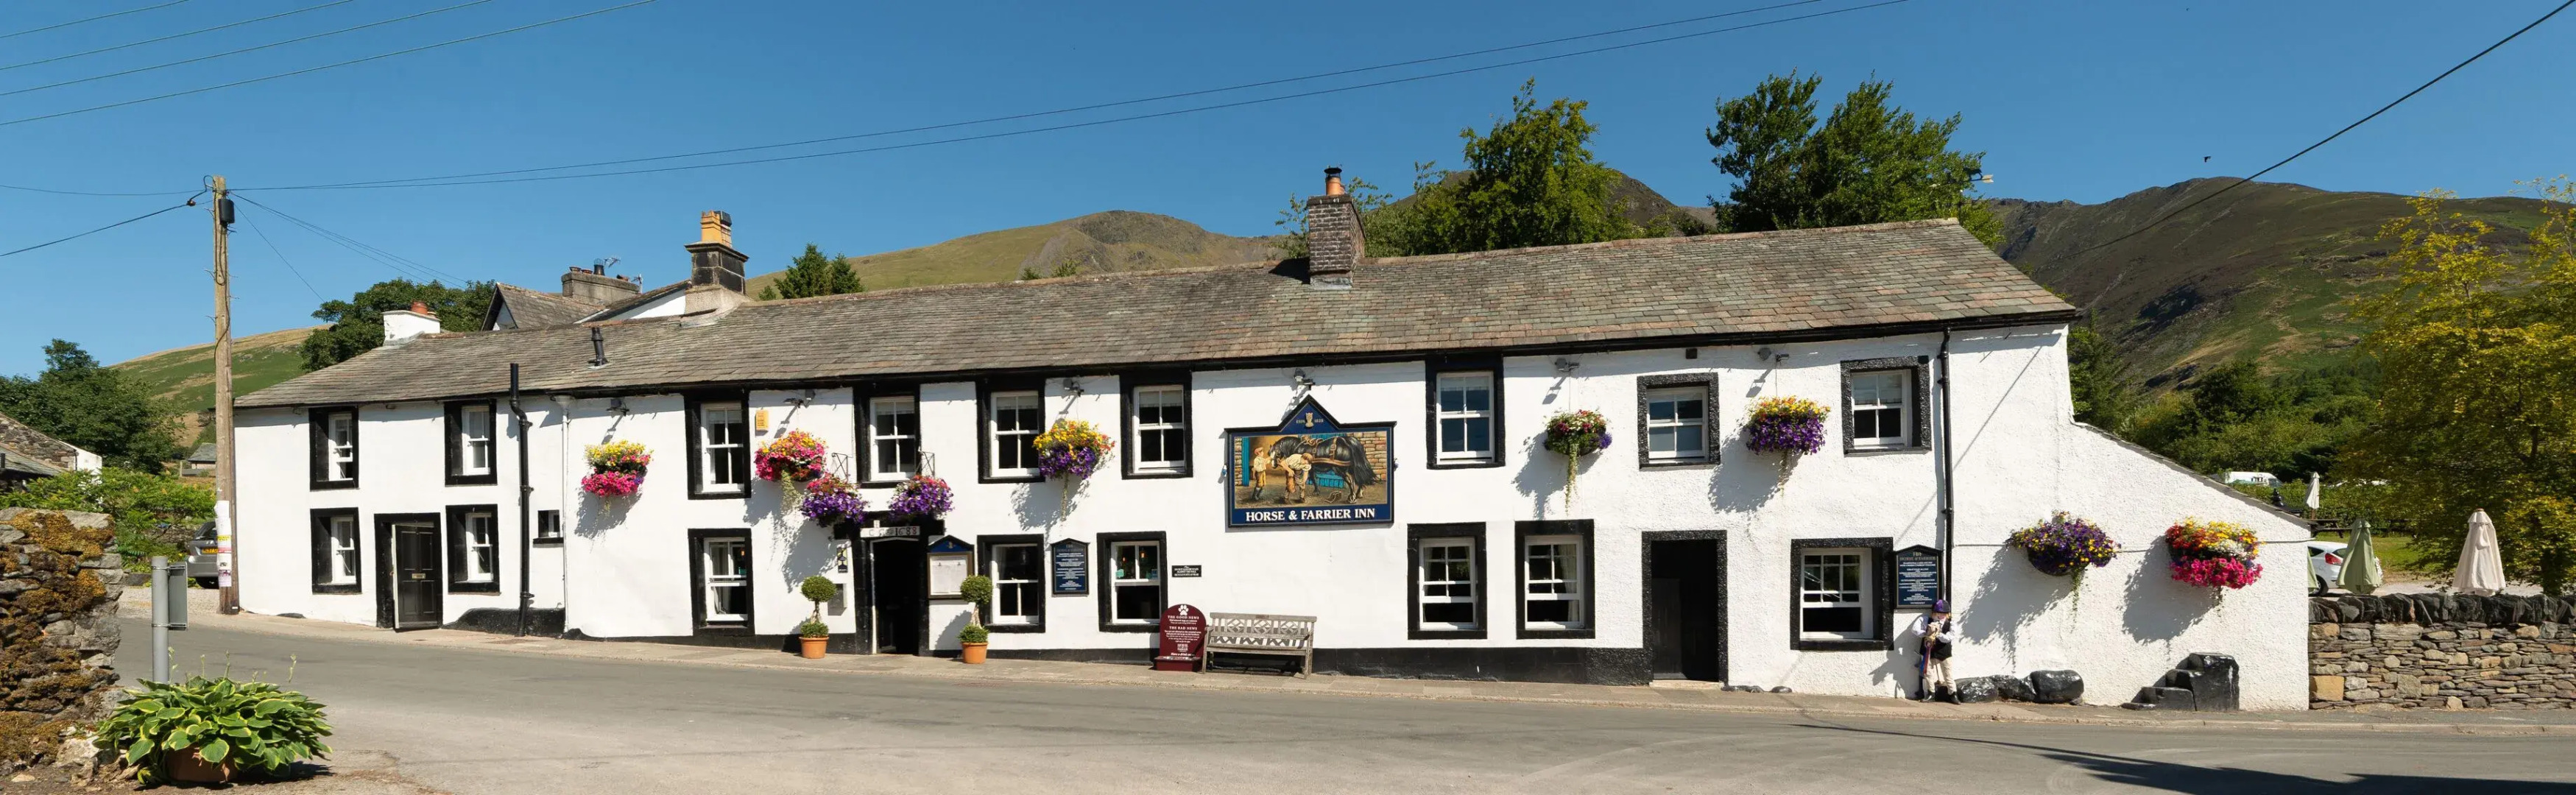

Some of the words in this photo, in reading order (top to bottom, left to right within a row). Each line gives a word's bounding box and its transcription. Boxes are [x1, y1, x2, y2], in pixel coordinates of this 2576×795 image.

[1246, 511, 1285, 522] HORSE
[1288, 510, 1298, 521] &
[1301, 509, 1352, 520] FARRIER
[1355, 508, 1376, 519] INN
